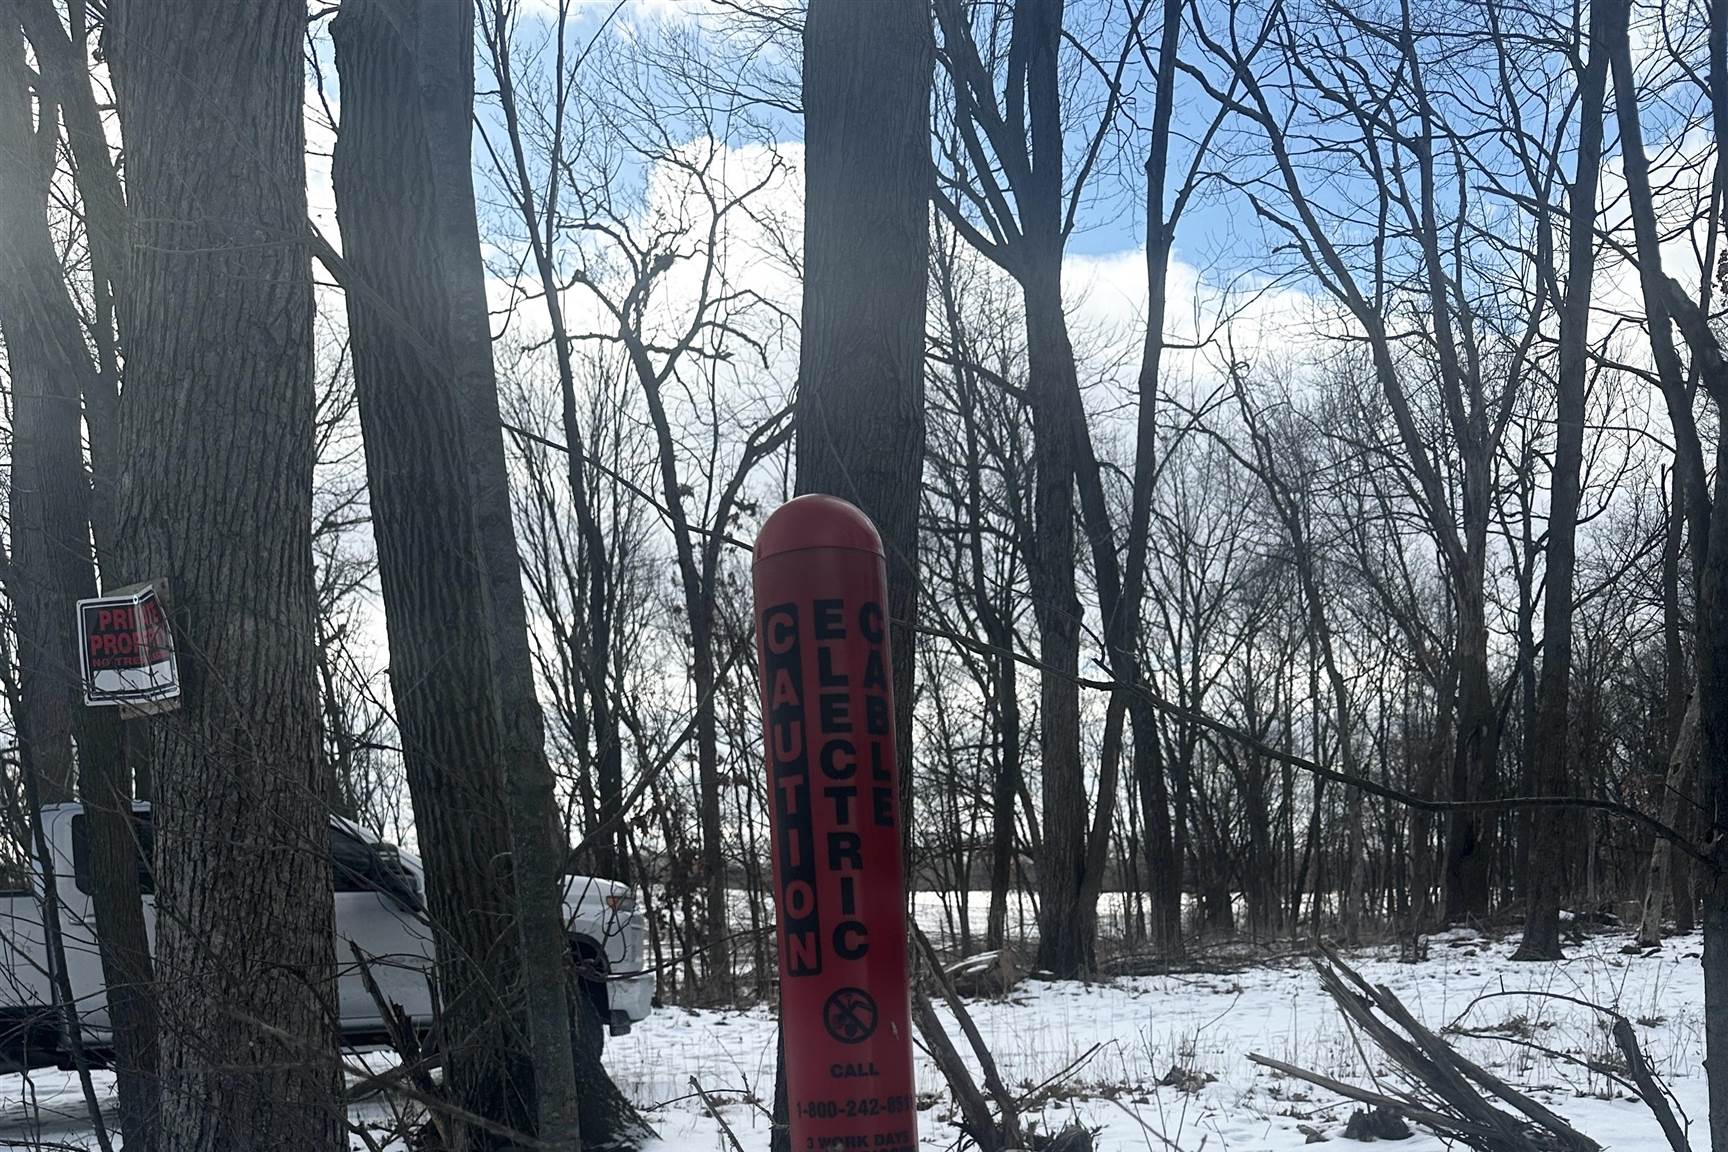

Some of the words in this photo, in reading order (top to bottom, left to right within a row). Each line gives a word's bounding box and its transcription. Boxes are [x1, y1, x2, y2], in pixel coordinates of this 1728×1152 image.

[767, 611, 818, 972] CAUTION
[813, 599, 869, 961] ELECTRIC
[859, 601, 895, 828] CABLE
[817, 1135, 868, 1150] WORK
[875, 1131, 910, 1147] DAYS
[830, 1063, 880, 1078] CALL
